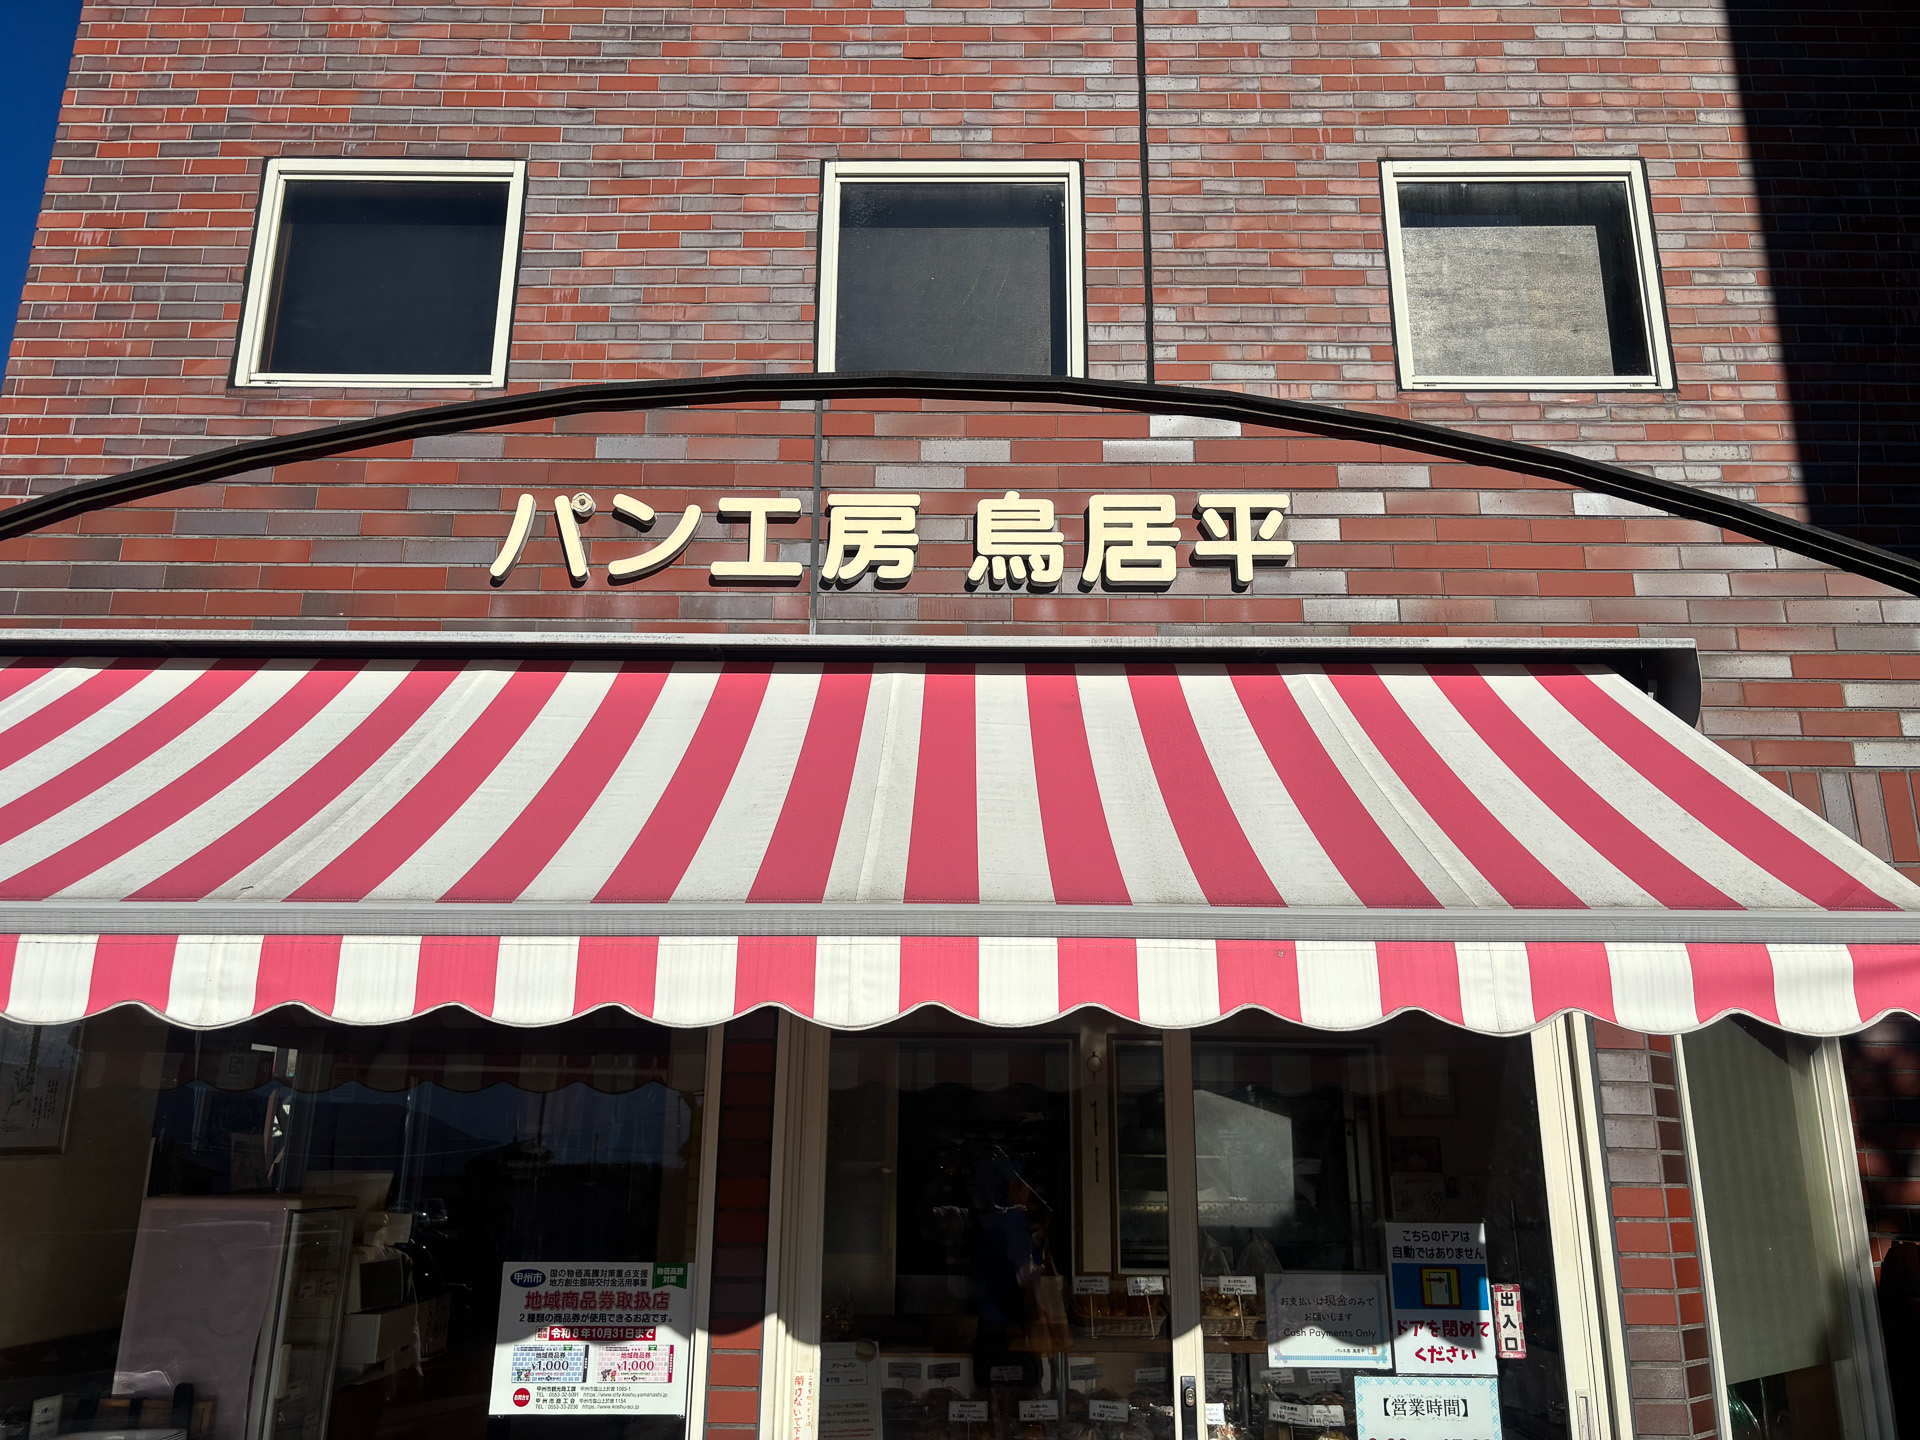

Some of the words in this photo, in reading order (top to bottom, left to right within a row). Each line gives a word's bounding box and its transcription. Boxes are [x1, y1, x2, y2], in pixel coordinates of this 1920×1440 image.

[490, 492, 921, 588] パン工房
[967, 490, 1296, 588] 鳥居平
[1402, 1230, 1471, 1243] こちらのドアは
[1392, 1246, 1484, 1260] 自動ではありません
[513, 1272, 543, 1283] 甲州市
[550, 1269, 648, 1278] 国の物価高騰対策重点支援
[549, 1278, 647, 1287] 地方創生臨時交付金活用事業
[524, 1291, 671, 1311] 地域商品券取扱店
[1280, 1295, 1375, 1307] お支払いは現金のみで
[1304, 1312, 1353, 1322] お願いします
[1499, 1292, 1519, 1352] 出入口
[1284, 1328, 1307, 1337] Cash
[1309, 1328, 1353, 1339] Payments
[1356, 1328, 1377, 1340] Only
[1396, 1319, 1490, 1338] ドアを閉めて
[1414, 1345, 1477, 1364] ください
[1383, 1397, 1469, 1418] 【営業時間】
